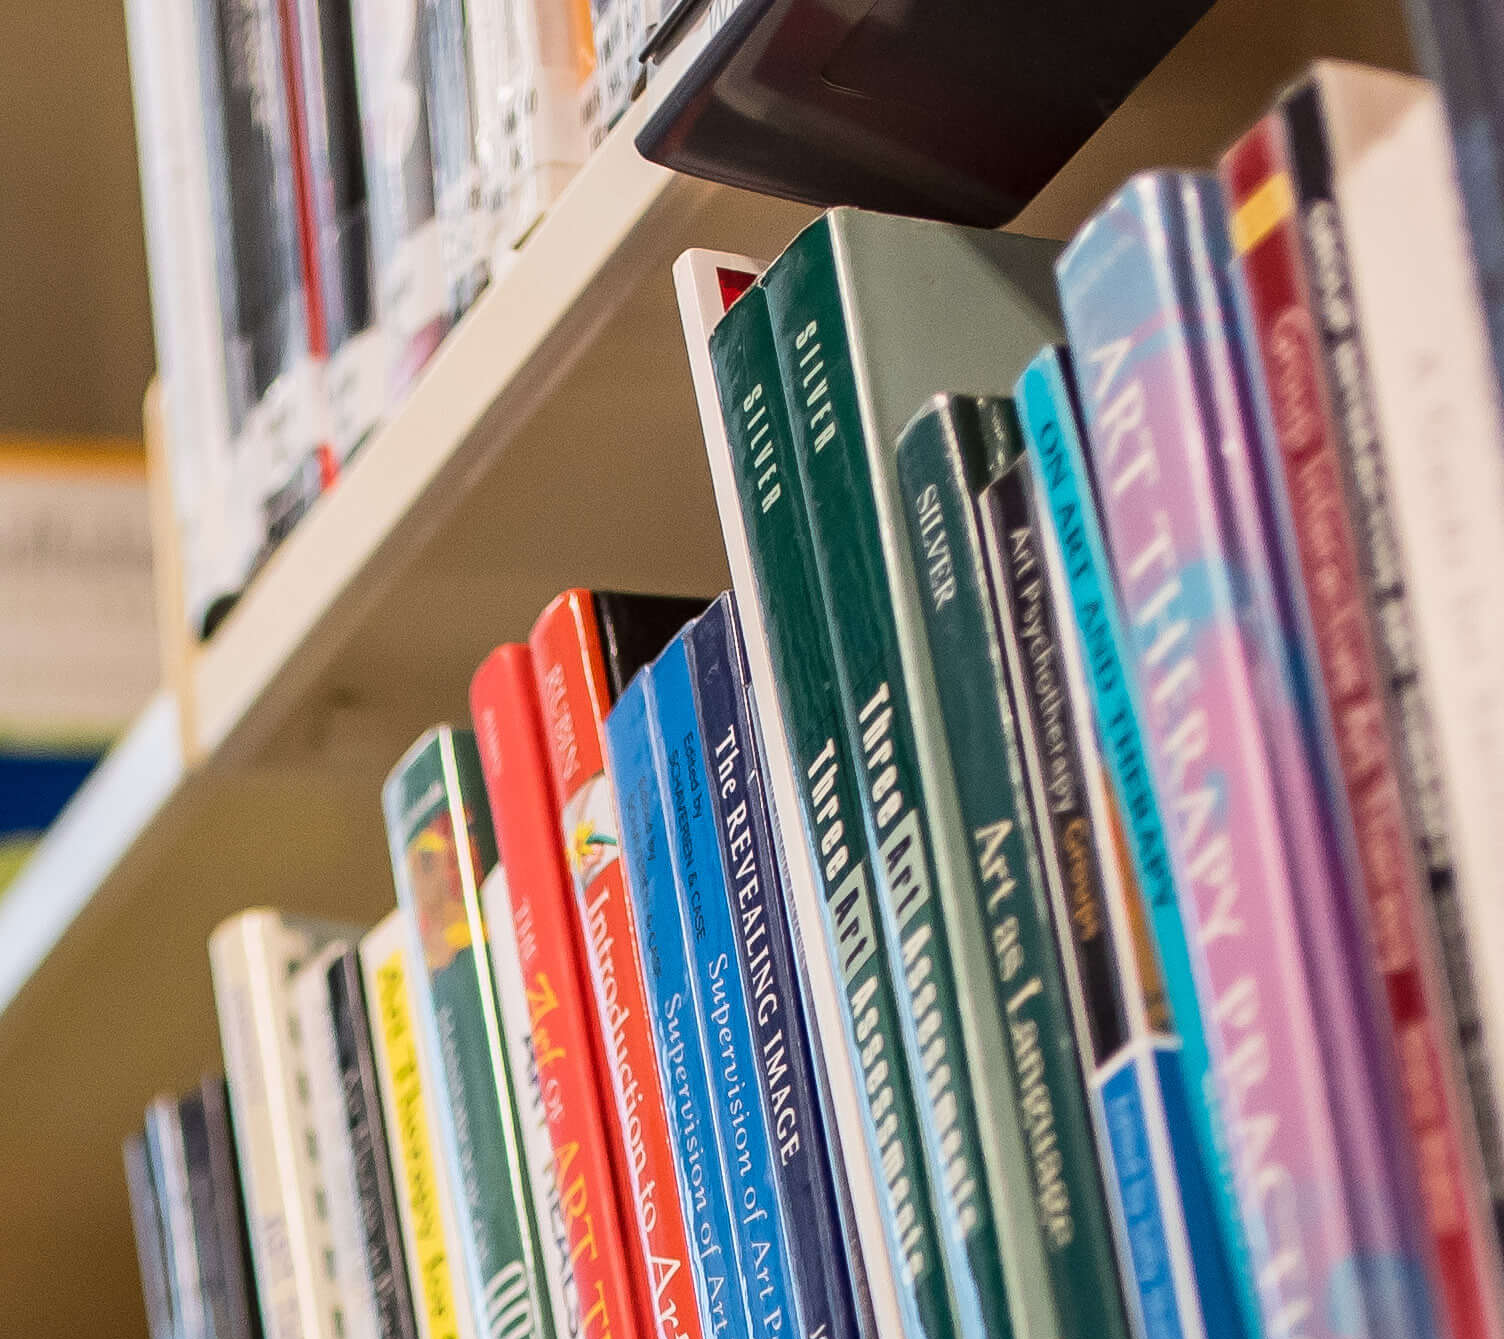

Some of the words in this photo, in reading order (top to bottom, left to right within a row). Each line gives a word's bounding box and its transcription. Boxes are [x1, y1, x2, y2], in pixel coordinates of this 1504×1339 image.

[740, 380, 782, 518] SILVER
[792, 314, 837, 457] SILVER
[913, 481, 958, 616] SILVER
[1033, 417, 1072, 494] ON
[1053, 498, 1094, 583] ART
[708, 723, 741, 800] The
[857, 680, 908, 832] Three
[886, 828, 921, 919] Art
[722, 807, 779, 1025] REVEALING
[804, 734, 853, 886] Three
[832, 881, 868, 973] Art
[971, 799, 1025, 917] Art
[989, 908, 1025, 987] as
[583, 880, 654, 1175] Introduction
[635, 1179, 667, 1235] to
[659, 989, 719, 1224] Supervision
[701, 950, 761, 1183] Supervision
[760, 1032, 801, 1168] IMAGE
[549, 1137, 603, 1267] ART
[697, 1225, 721, 1258] of
[739, 1182, 768, 1226] of
[748, 1235, 779, 1301] Art
[705, 1272, 731, 1331] Art
